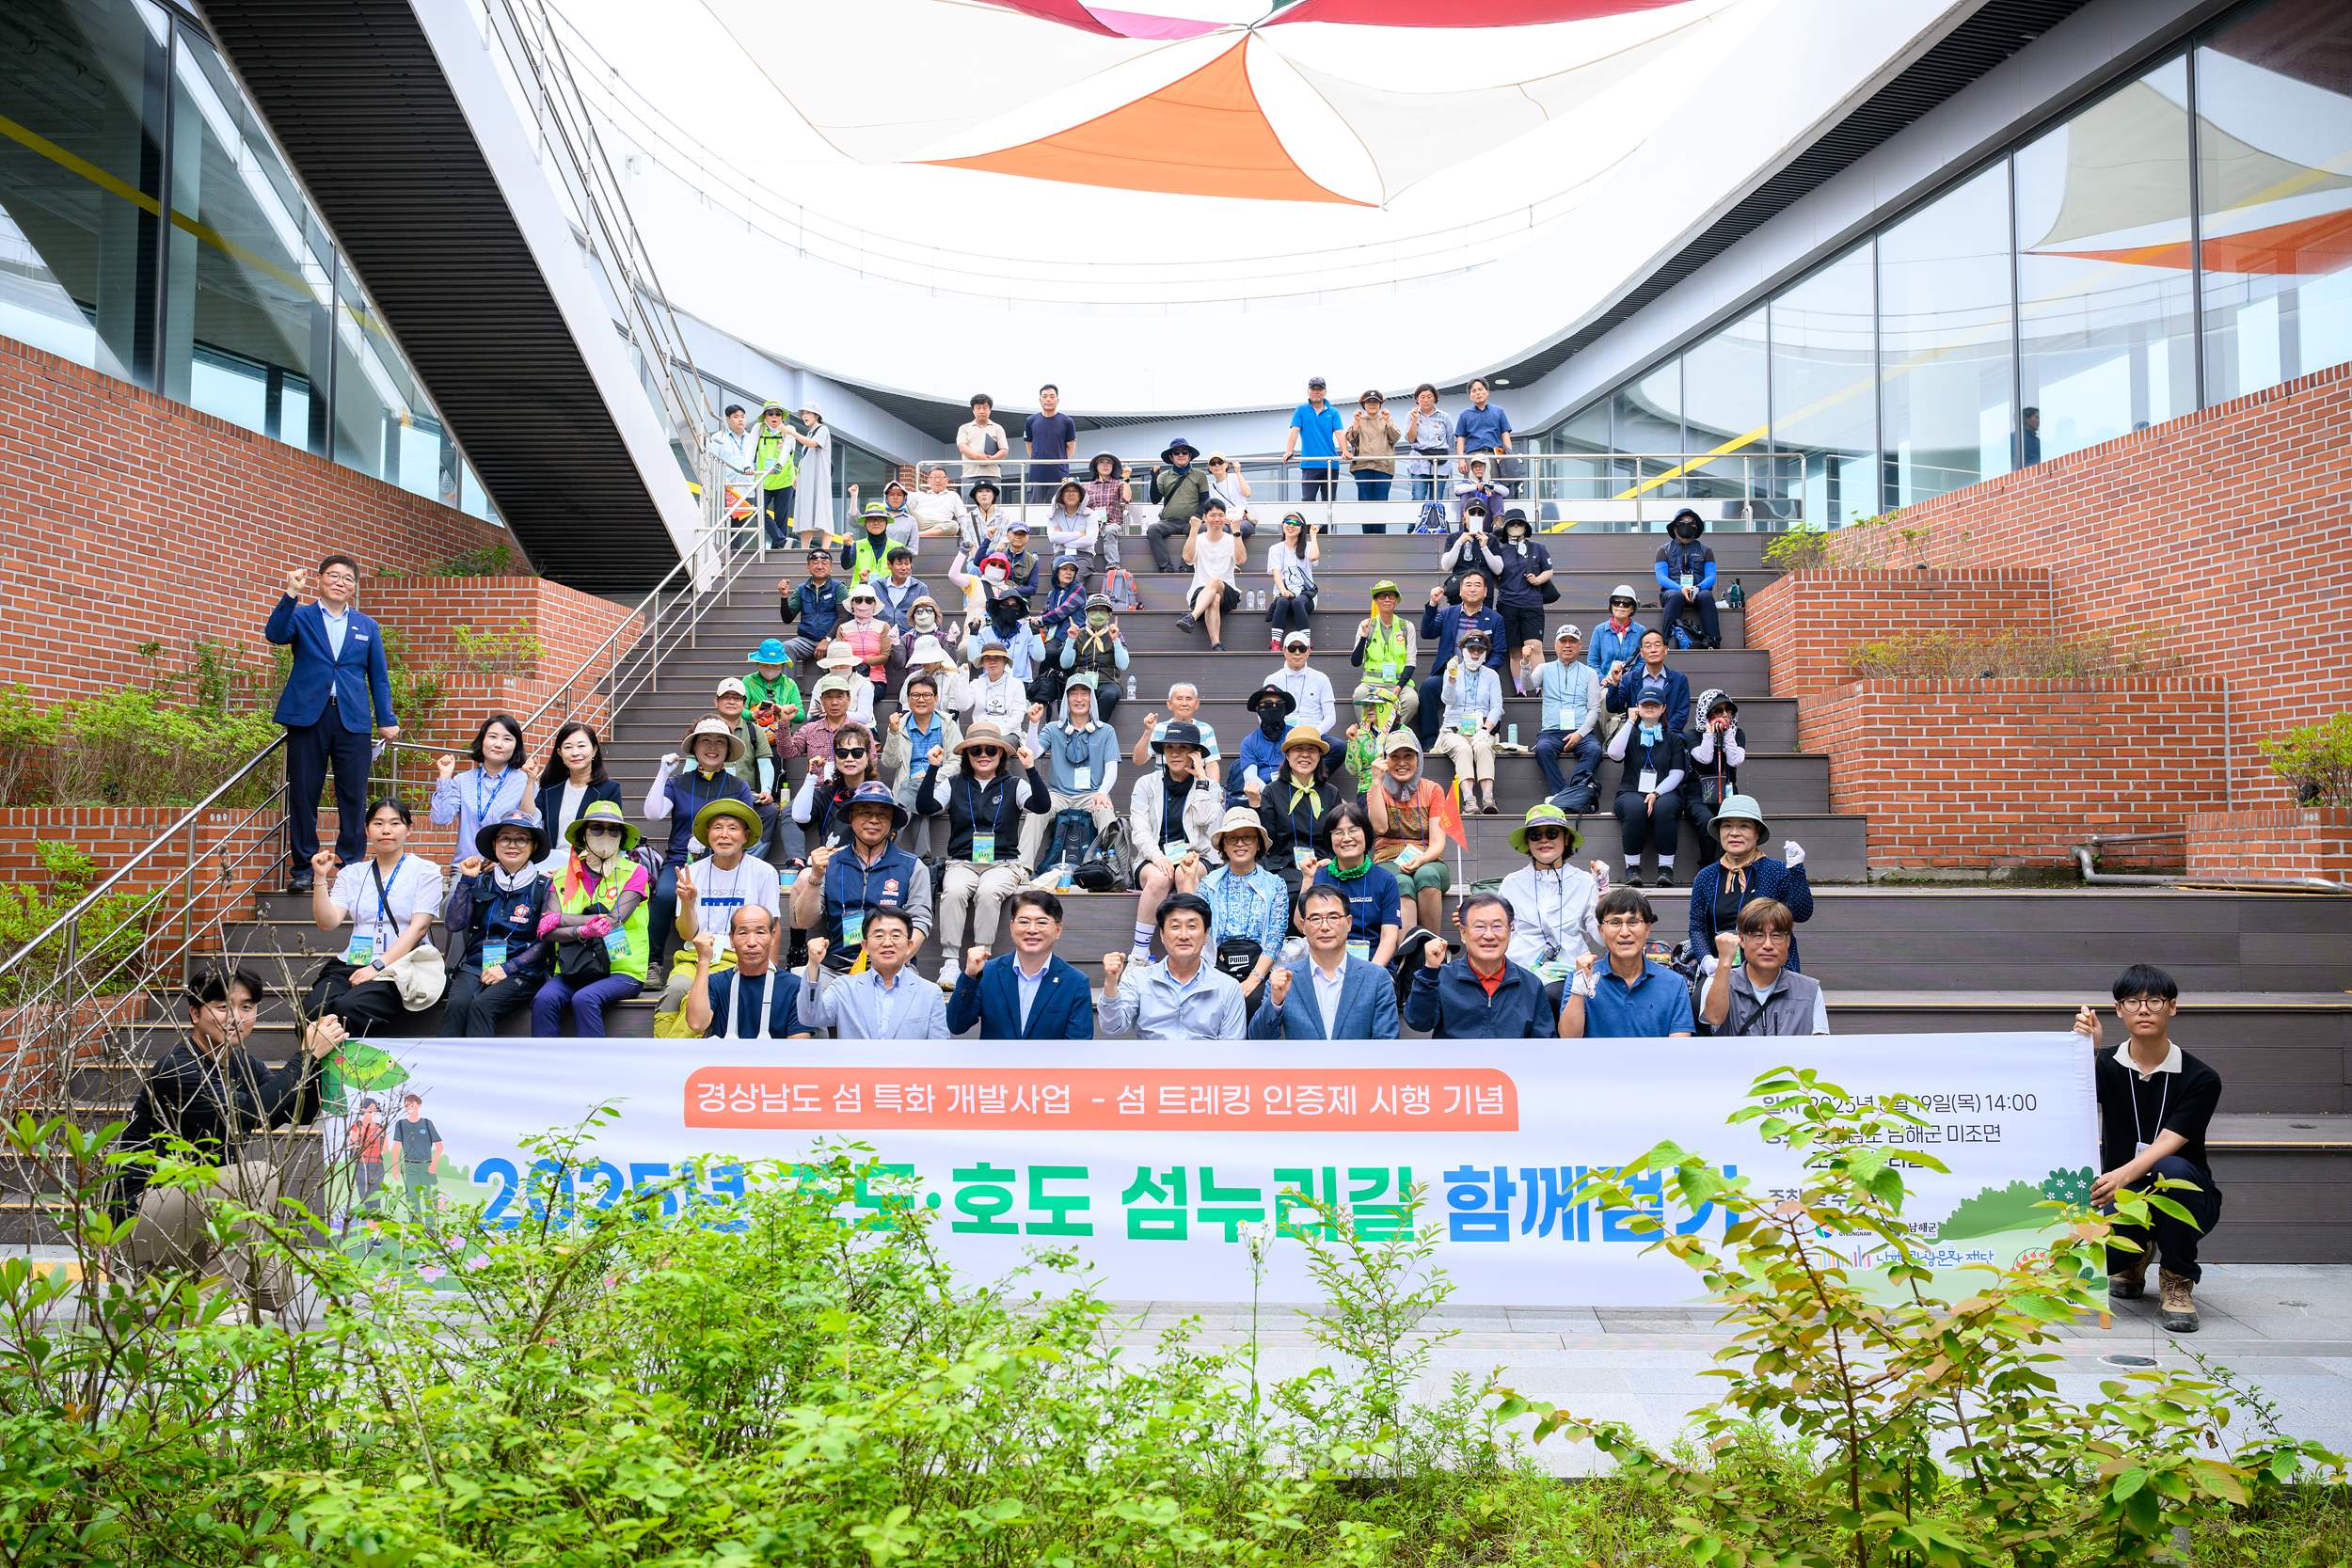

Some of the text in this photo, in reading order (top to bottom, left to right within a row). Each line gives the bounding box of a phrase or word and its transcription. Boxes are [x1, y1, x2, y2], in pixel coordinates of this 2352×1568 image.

[697, 1083, 822, 1114] 경상남도
[833, 1084, 861, 1114] 섬
[873, 1084, 936, 1114] 특화
[946, 1084, 1071, 1115] 개발사업
[1116, 1084, 1146, 1115] 섬
[1157, 1084, 1250, 1116] 트레킹
[1263, 1084, 1358, 1116] 인증제
[1369, 1084, 1431, 1116] 시행
[1443, 1084, 1505, 1116] 기념
[1985, 1093, 2037, 1113] 14:00
[1947, 1124, 2002, 1144] 미조면
[1121, 1165, 1415, 1243] 섬누리길
[1909, 1223, 1937, 1233] 남해군
[1965, 1250, 1994, 1265] 재단
